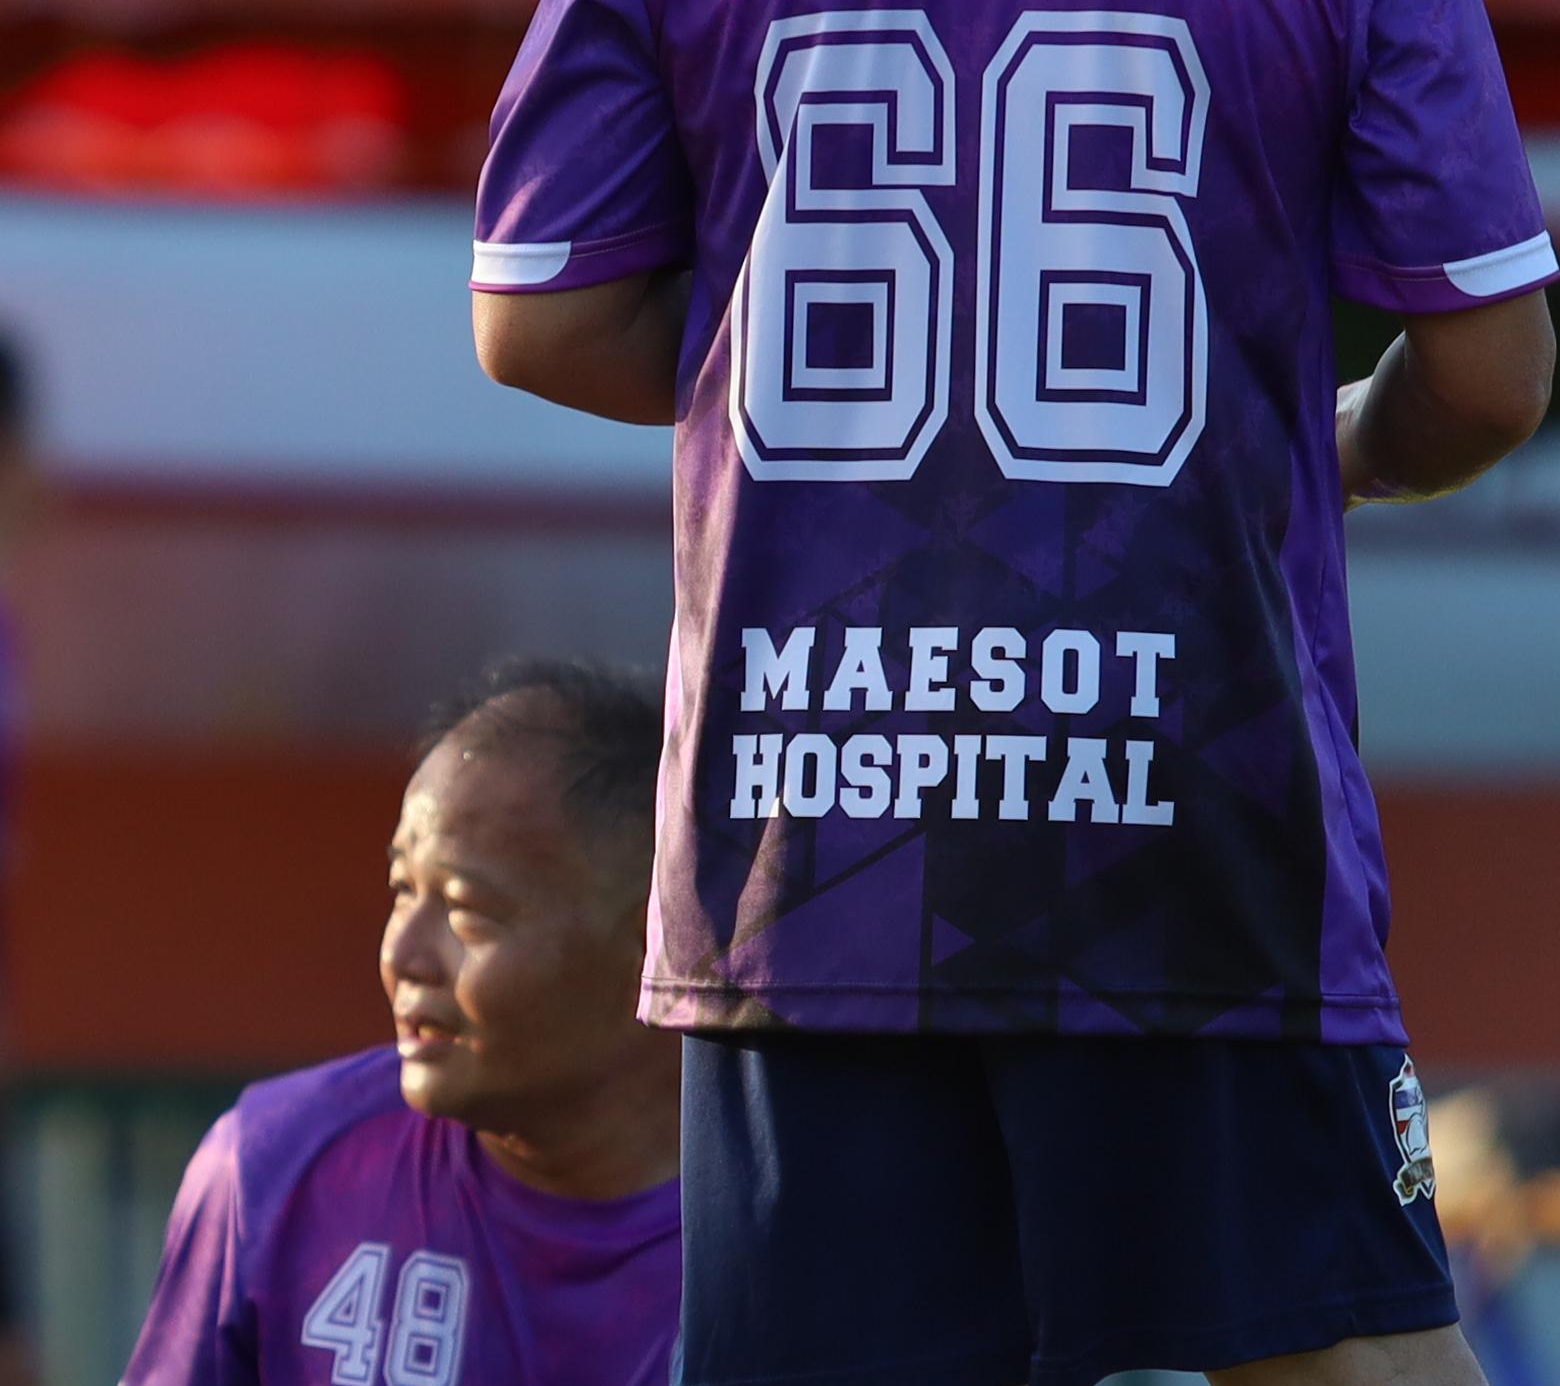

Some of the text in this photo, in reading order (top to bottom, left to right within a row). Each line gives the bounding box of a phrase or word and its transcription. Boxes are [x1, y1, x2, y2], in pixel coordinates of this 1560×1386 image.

[728, 8, 1211, 488] 66
[739, 626, 1177, 718] MAESOT
[729, 732, 1175, 826] HOSPITAL
